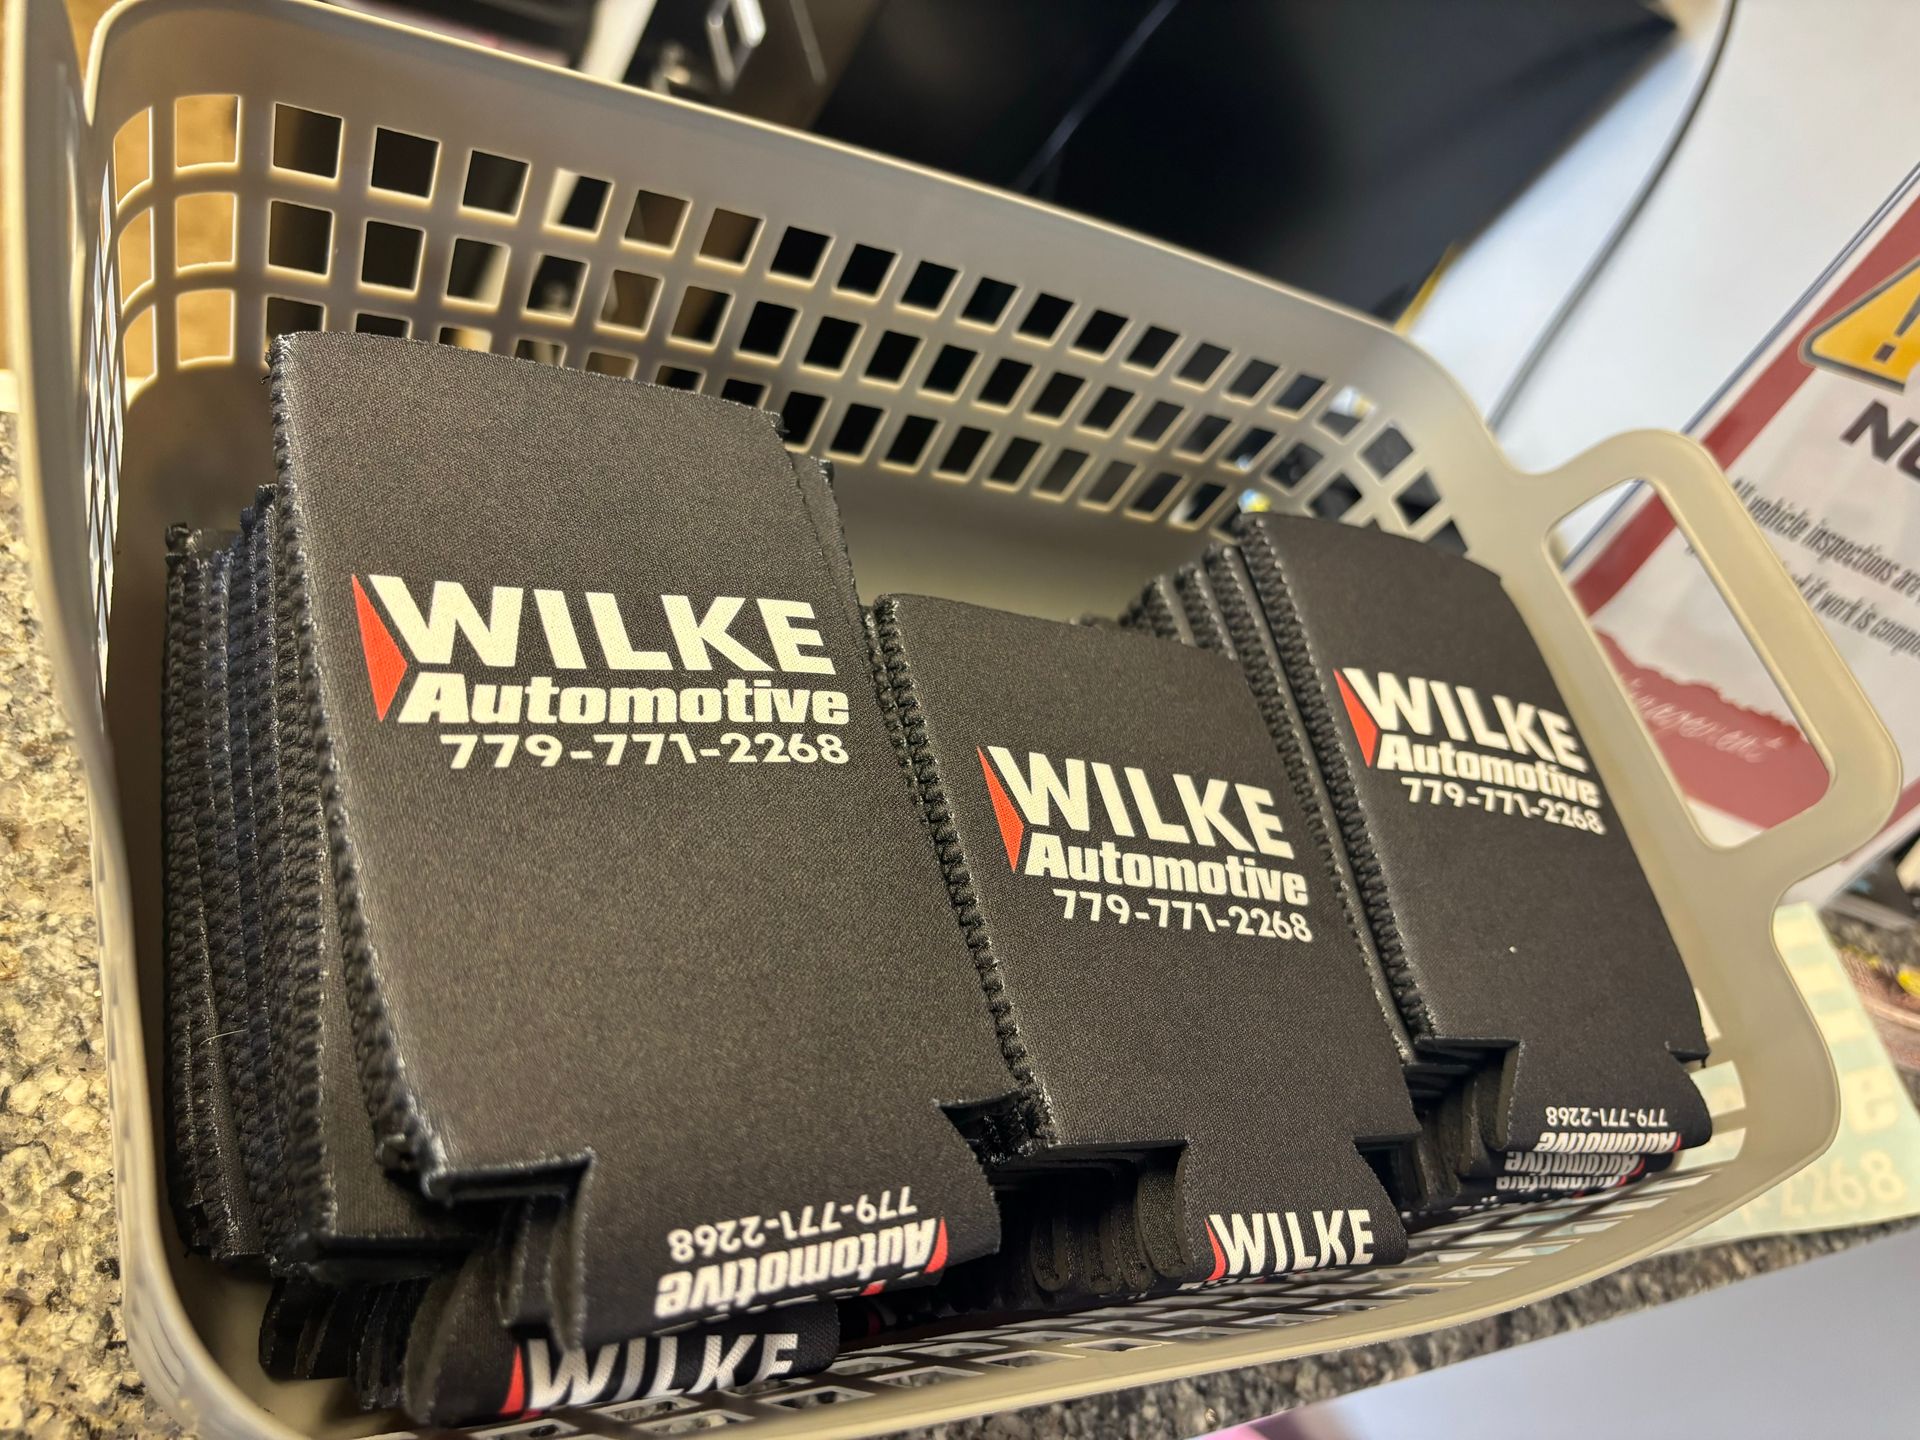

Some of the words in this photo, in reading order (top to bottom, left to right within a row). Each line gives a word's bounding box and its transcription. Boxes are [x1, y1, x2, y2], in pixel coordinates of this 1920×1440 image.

[1748, 497, 1810, 542] vehicle
[1801, 518, 1901, 585] inspections
[369, 574, 836, 675] WILKE
[1813, 588, 1866, 627] work
[1850, 602, 1878, 634] is
[1868, 616, 1920, 660] comple
[399, 672, 850, 724] Automotive
[1342, 667, 1590, 773] WILKE
[440, 733, 850, 769] 779-771-2268
[1377, 733, 1601, 808] Automotive
[987, 745, 1295, 860] WILKE
[1400, 777, 1607, 836] 779-771-2268
[1024, 832, 1309, 905] Automotive
[1053, 888, 1313, 943] 779-771-2268
[1545, 1107, 1668, 1127] 779-771-2268
[667, 1185, 918, 1264] 779-771-2268
[1209, 1209, 1374, 1275] WILKE
[654, 1217, 936, 1318] Automotive
[527, 1333, 798, 1410] WILKE
